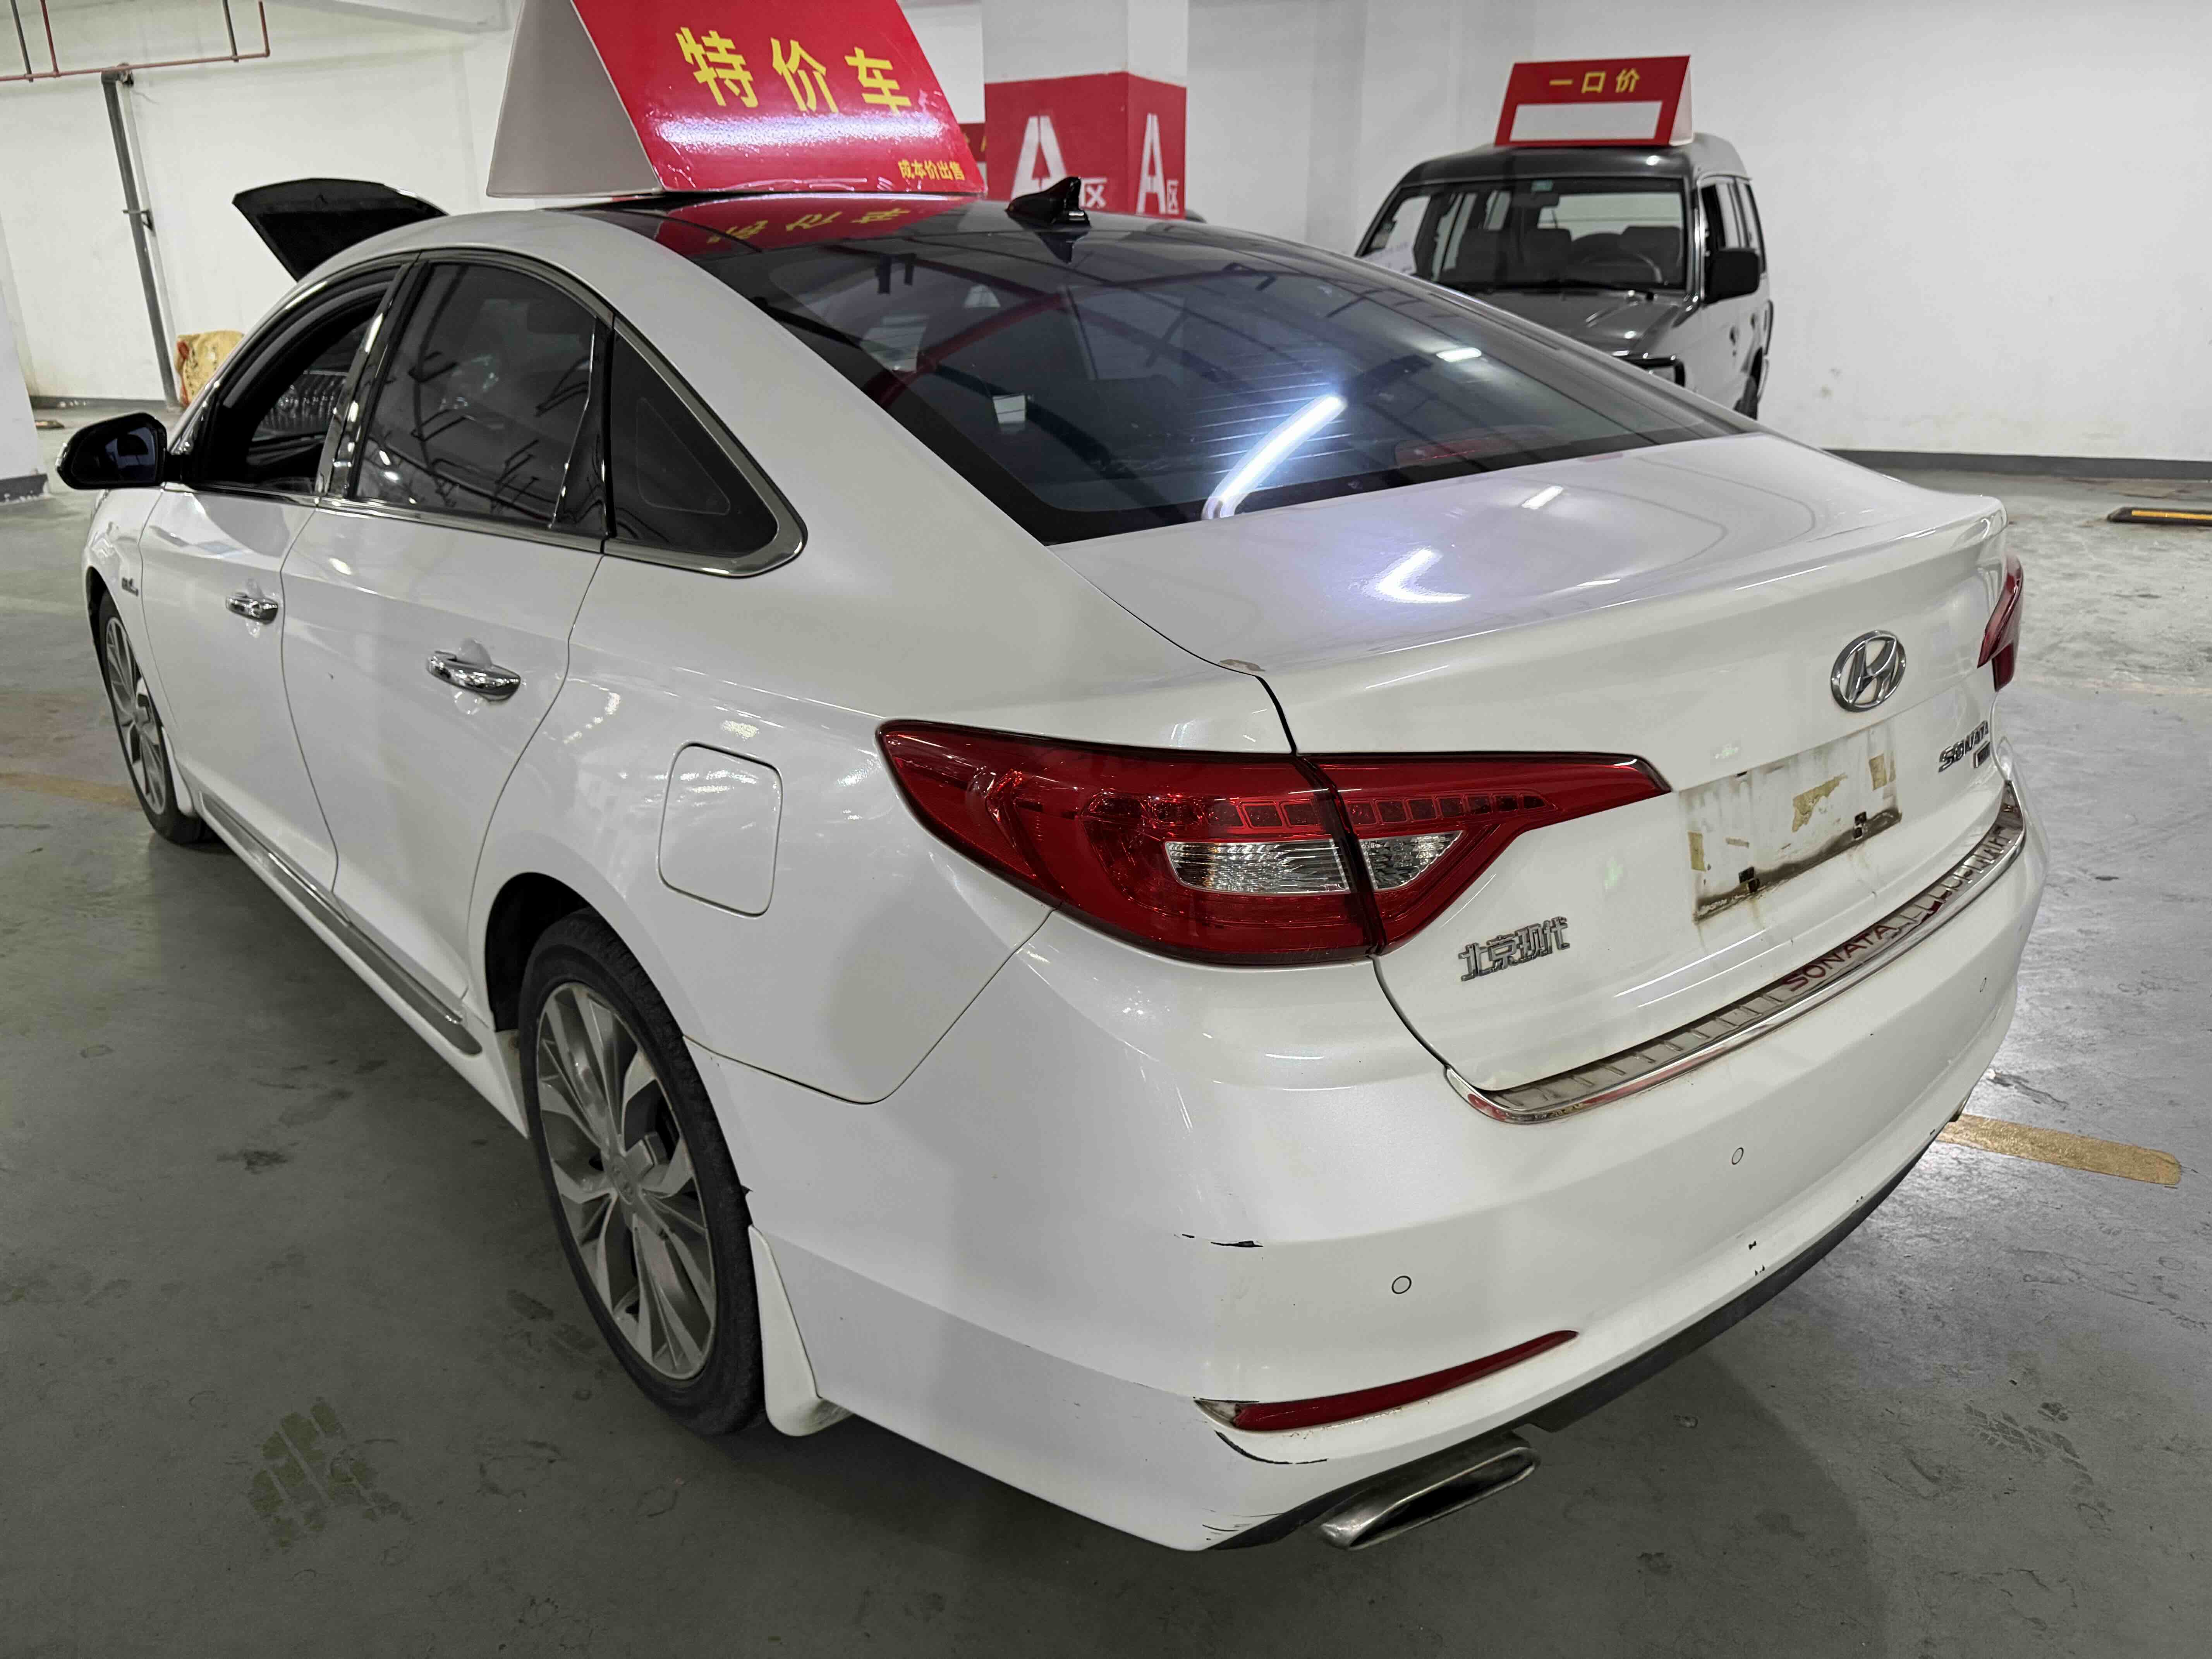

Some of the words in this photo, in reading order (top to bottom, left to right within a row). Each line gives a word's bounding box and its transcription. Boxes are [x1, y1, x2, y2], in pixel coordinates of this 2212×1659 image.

[676, 27, 911, 115] 特价车
[1549, 68, 1640, 93] 一口价
[898, 159, 965, 180] 成本价出售
[1939, 720, 1989, 773] SONATA
[1458, 916, 1570, 982] 北京现代
[1781, 924, 1898, 992] SONATA
